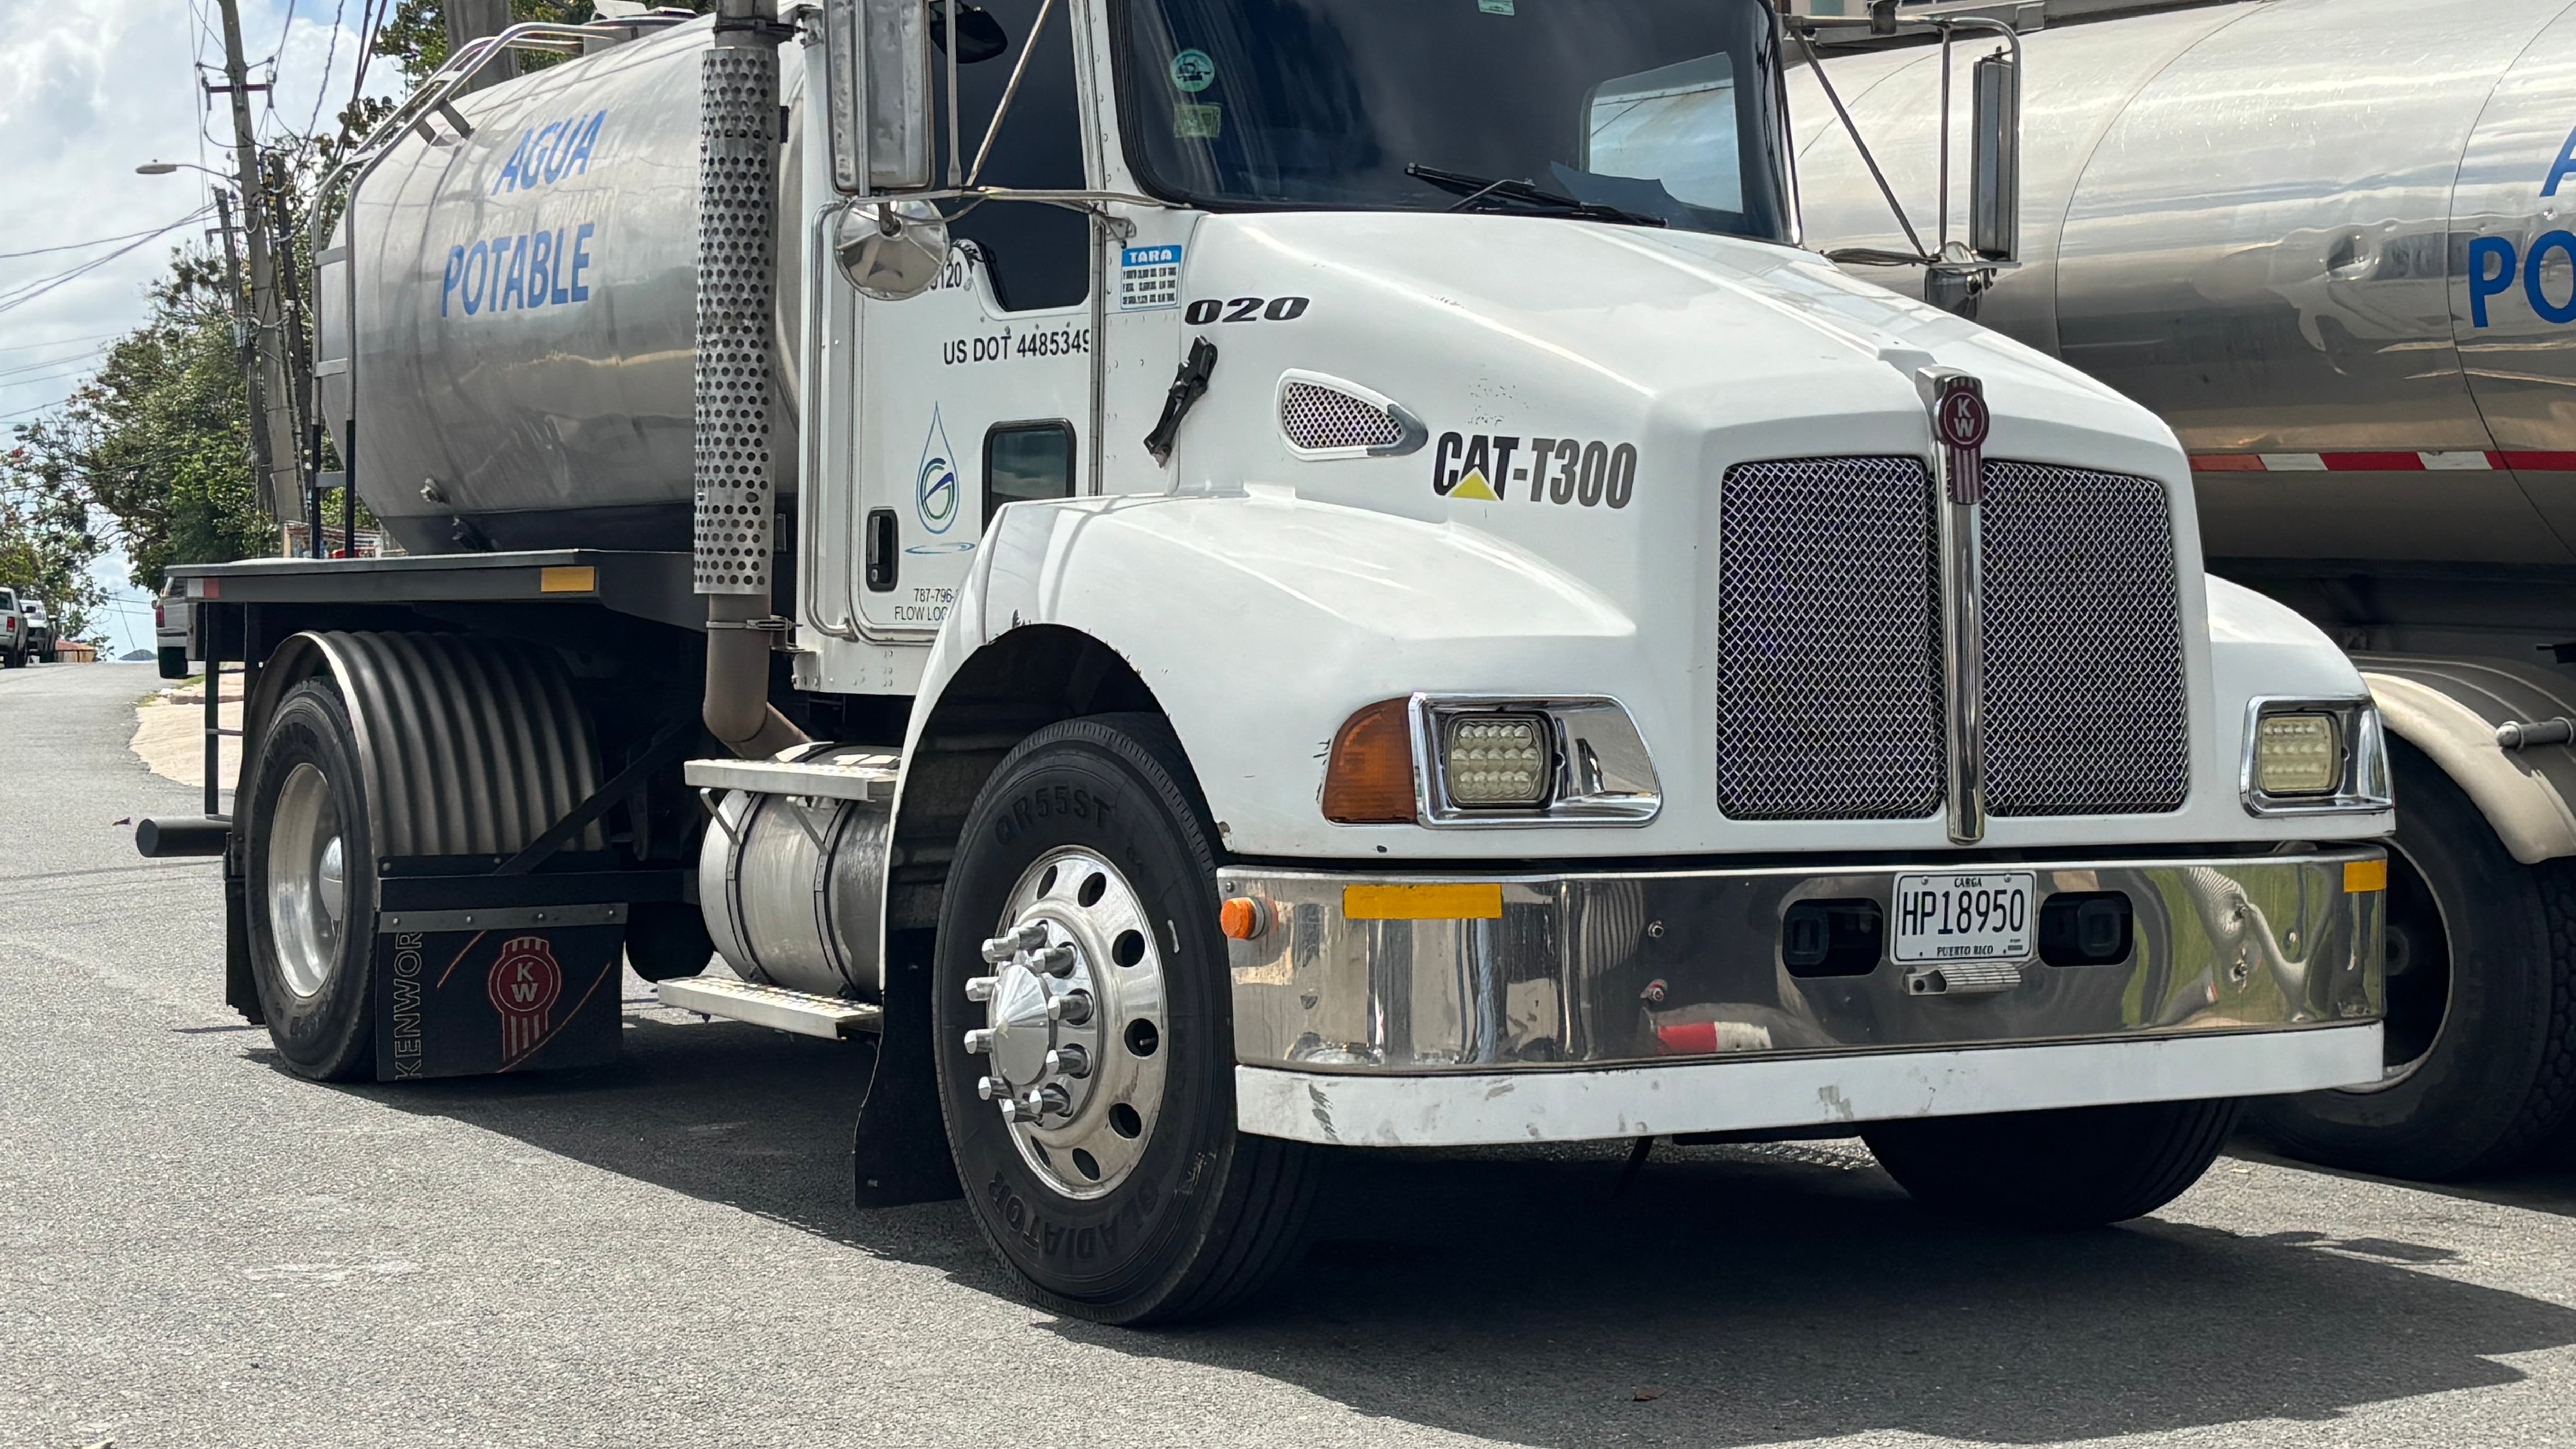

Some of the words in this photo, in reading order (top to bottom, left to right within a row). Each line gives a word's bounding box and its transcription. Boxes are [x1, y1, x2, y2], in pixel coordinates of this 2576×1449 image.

[491, 109, 608, 196] AGUA
[442, 223, 595, 318] POTABLE
[1129, 249, 1172, 264] TARA
[2468, 230, 2576, 328] PO
[1185, 297, 1309, 325] 020
[944, 339, 967, 365] US
[974, 335, 1011, 362] DOT
[1017, 329, 1089, 358] 4485349
[914, 588, 958, 603] 787-796-
[895, 606, 925, 621] FLOW
[1954, 877, 1982, 888] CARGA
[1902, 889, 2025, 936] HP18950
[1937, 946, 1971, 957] PUERTO
[1974, 945, 1993, 956] RICO
